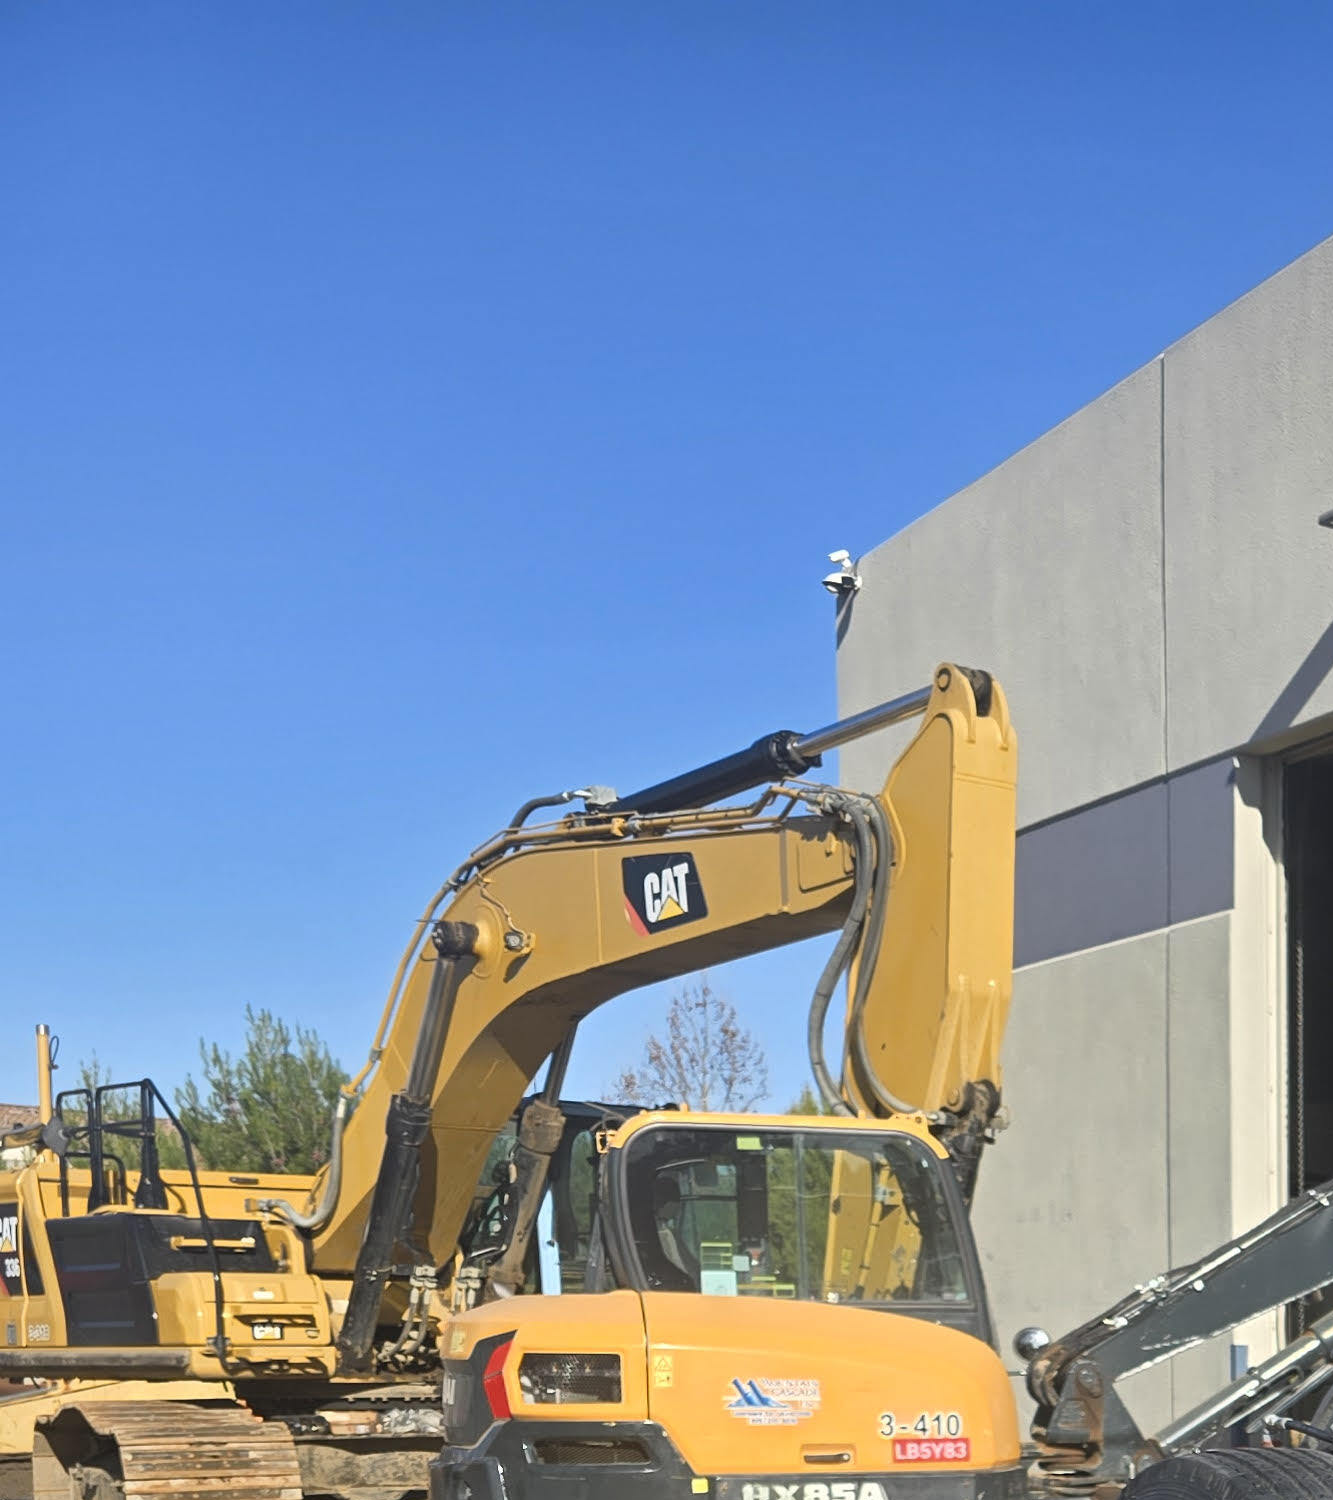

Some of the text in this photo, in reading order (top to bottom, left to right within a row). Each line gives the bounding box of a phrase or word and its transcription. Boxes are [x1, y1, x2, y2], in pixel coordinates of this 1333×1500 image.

[643, 862, 689, 924] CAT
[880, 1414, 960, 1437] 3-410
[894, 1441, 968, 1460] LB5Y83
